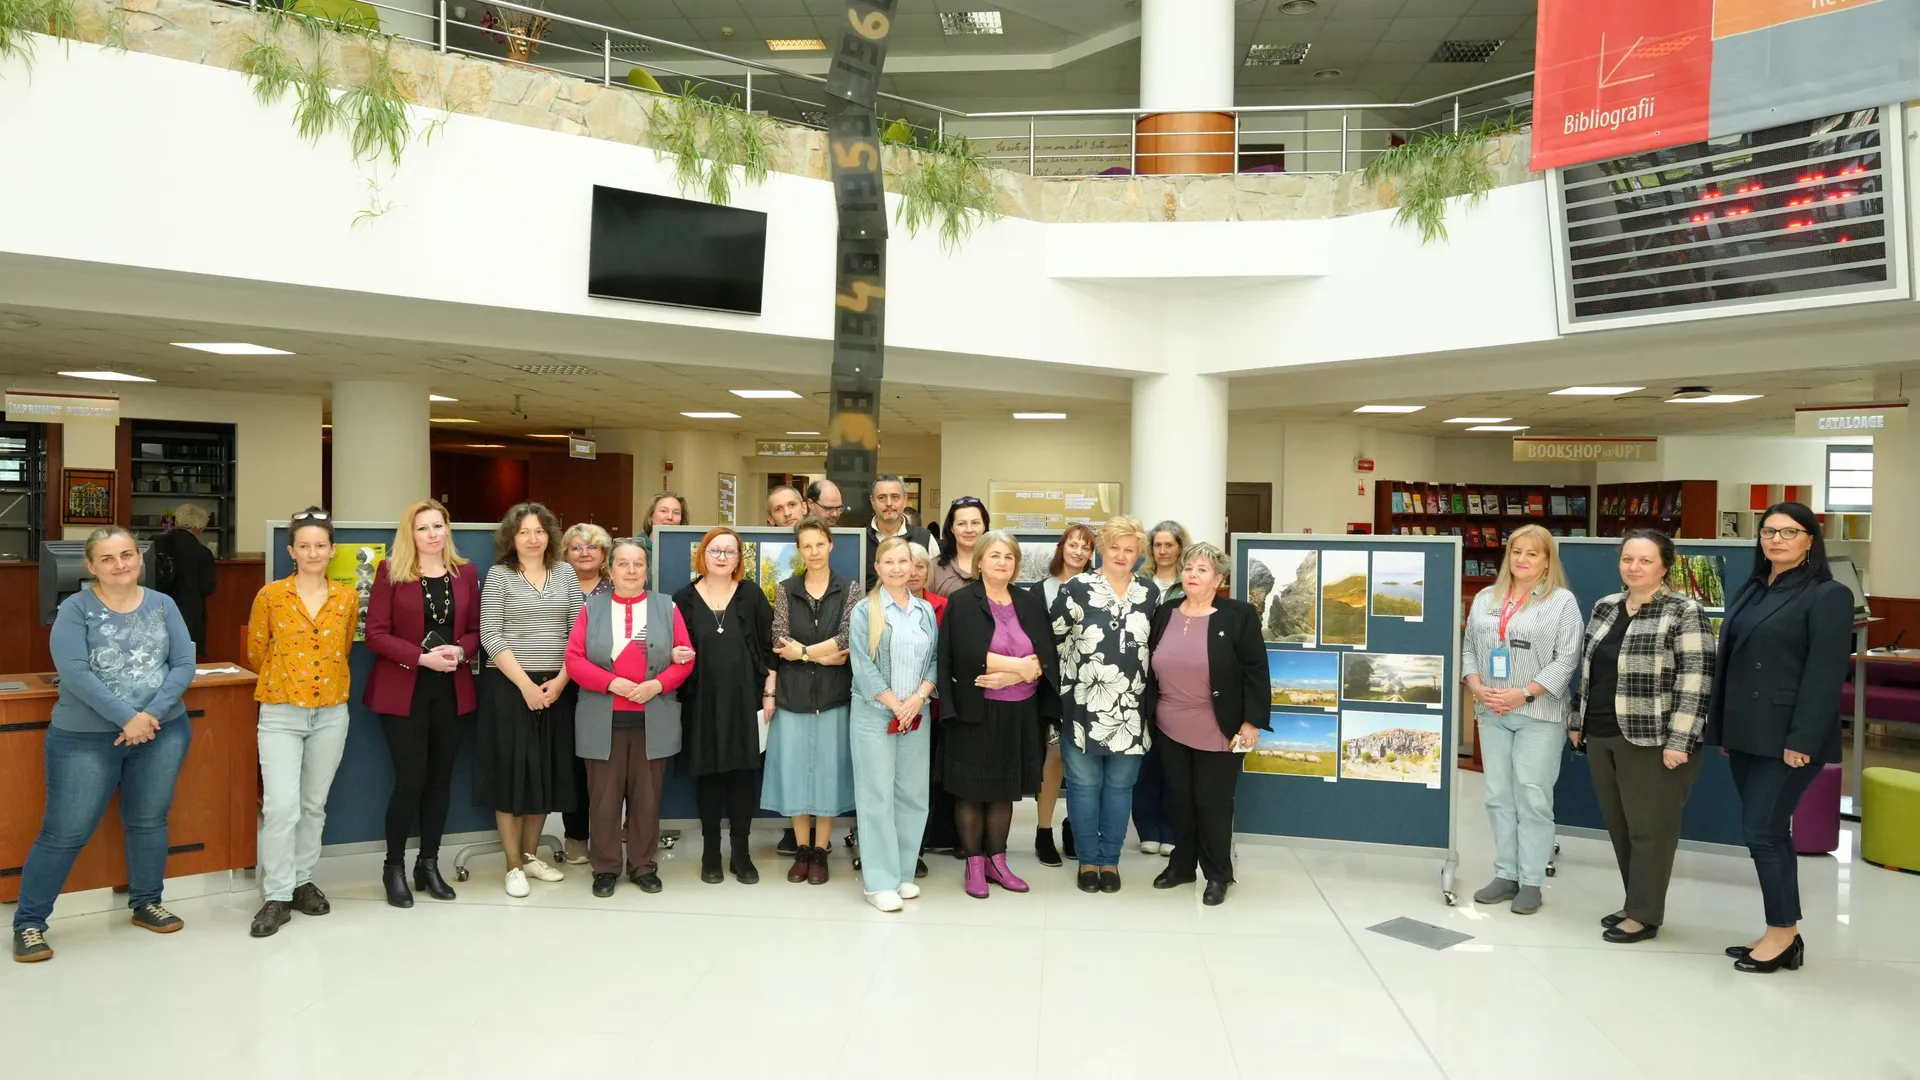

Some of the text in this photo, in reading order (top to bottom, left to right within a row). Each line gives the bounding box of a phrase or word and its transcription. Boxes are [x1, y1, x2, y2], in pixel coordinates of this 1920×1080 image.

[1563, 97, 1655, 135] Bibliografii
[1819, 415, 1884, 430] CATALOAGE
[1528, 444, 1642, 460] BOOKSHOP@UPT
